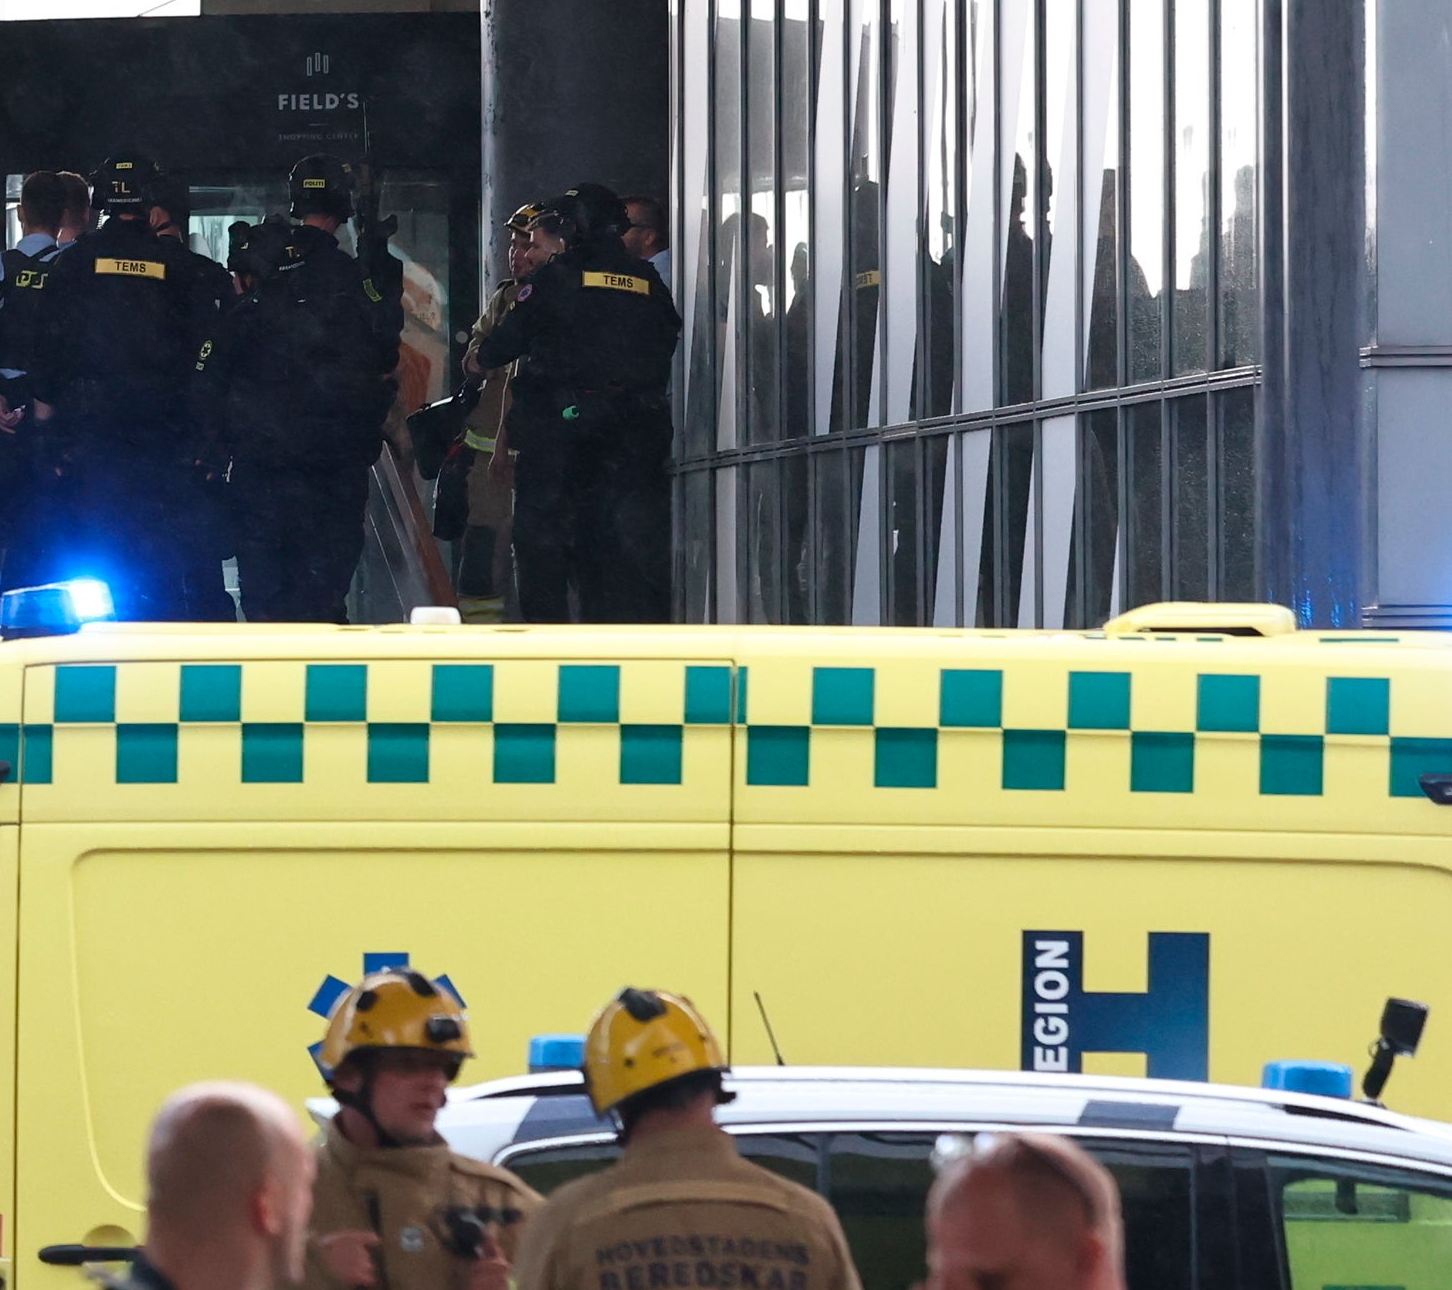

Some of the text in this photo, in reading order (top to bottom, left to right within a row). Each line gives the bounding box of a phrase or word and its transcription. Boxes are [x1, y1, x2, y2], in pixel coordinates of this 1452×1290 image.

[278, 93, 359, 110] FIELD'S
[285, 246, 300, 258] T
[115, 261, 146, 273] TEMS
[604, 274, 634, 288] TEMS
[1033, 938, 1069, 1073] EGION
